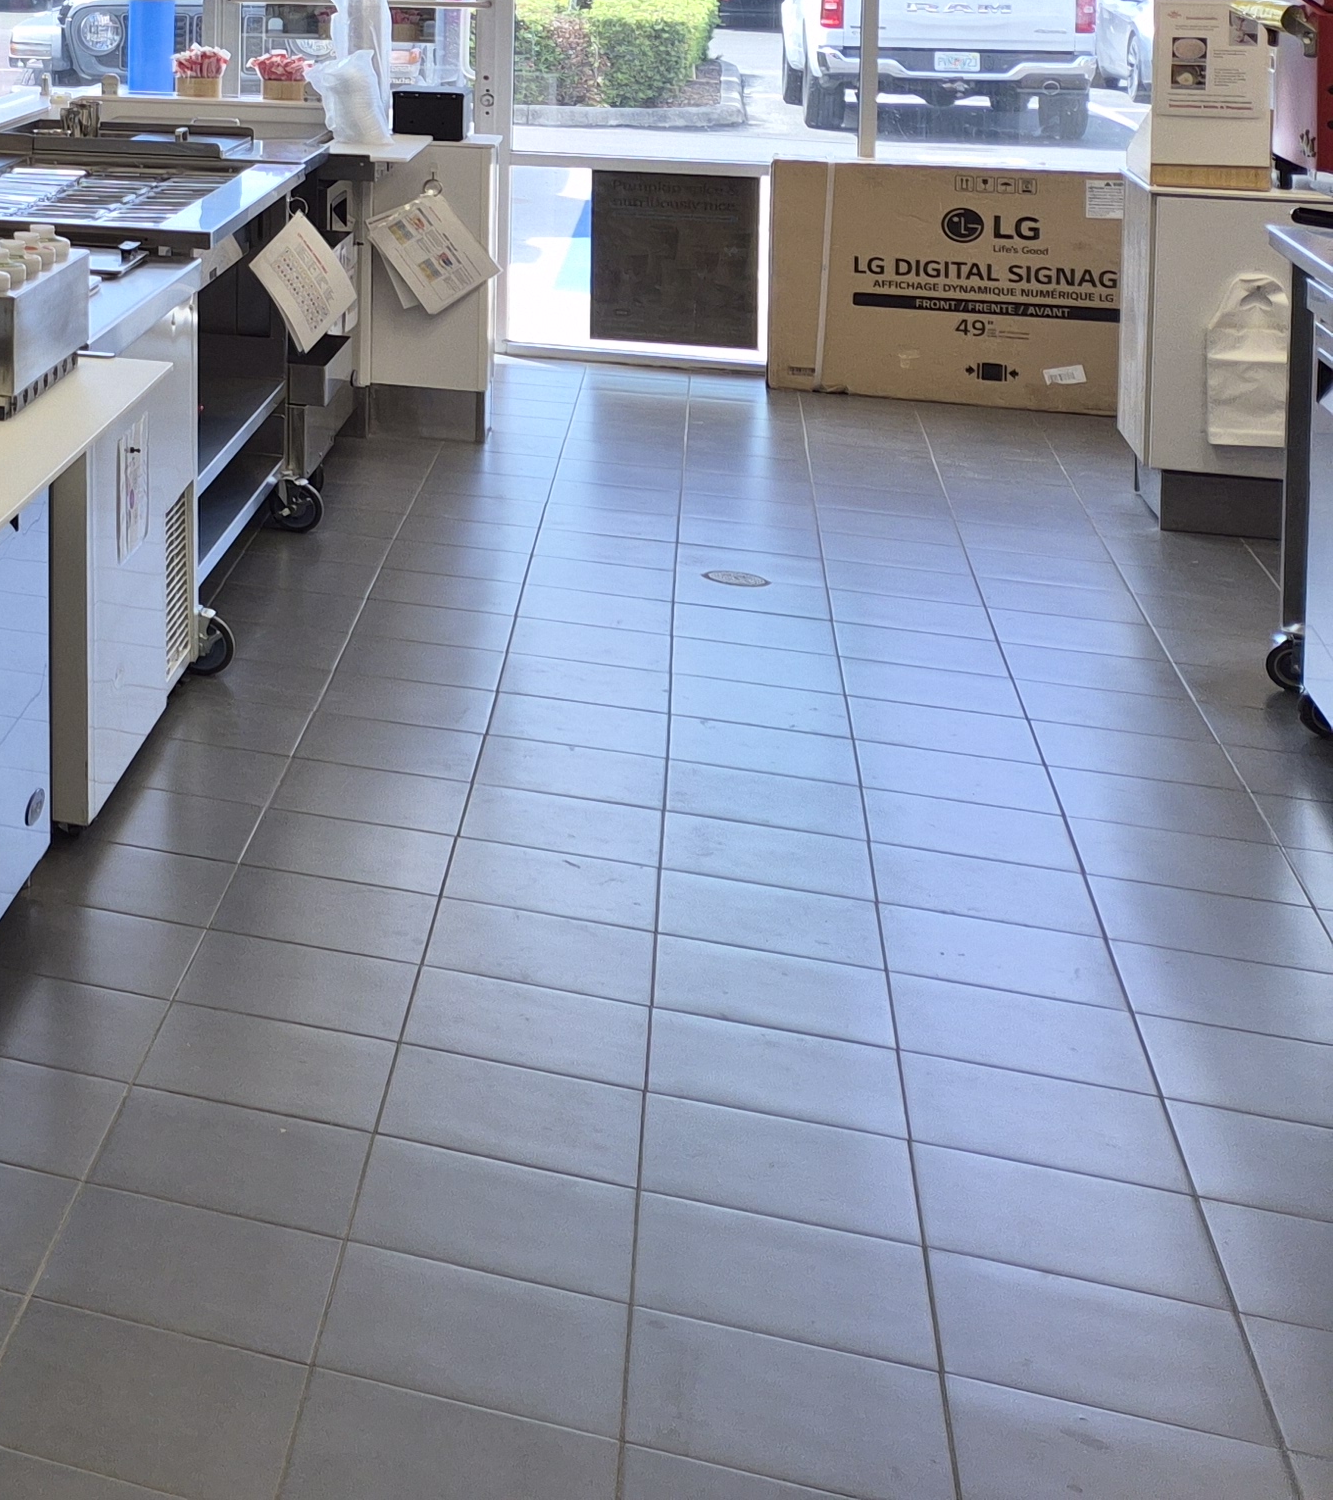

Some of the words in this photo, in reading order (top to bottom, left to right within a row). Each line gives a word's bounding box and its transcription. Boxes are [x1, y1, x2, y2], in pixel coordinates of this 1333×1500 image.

[906, 2, 1013, 14] RAM
[993, 215, 1041, 241] LG
[992, 244, 1019, 254] Life's
[1021, 245, 1049, 256] Good
[853, 255, 885, 275] LG
[894, 257, 1000, 282] DIGITAL
[1007, 264, 1119, 289] SIGNAG
[872, 278, 940, 293] AFFICHAGE
[942, 283, 1017, 299] DYNAMIQUE
[1020, 285, 1096, 303] NUMÉRIQUE
[1098, 292, 1115, 303] LG
[915, 298, 957, 311] FRONT
[968, 301, 1016, 315] FRENTE
[1027, 305, 1070, 318] AVANT
